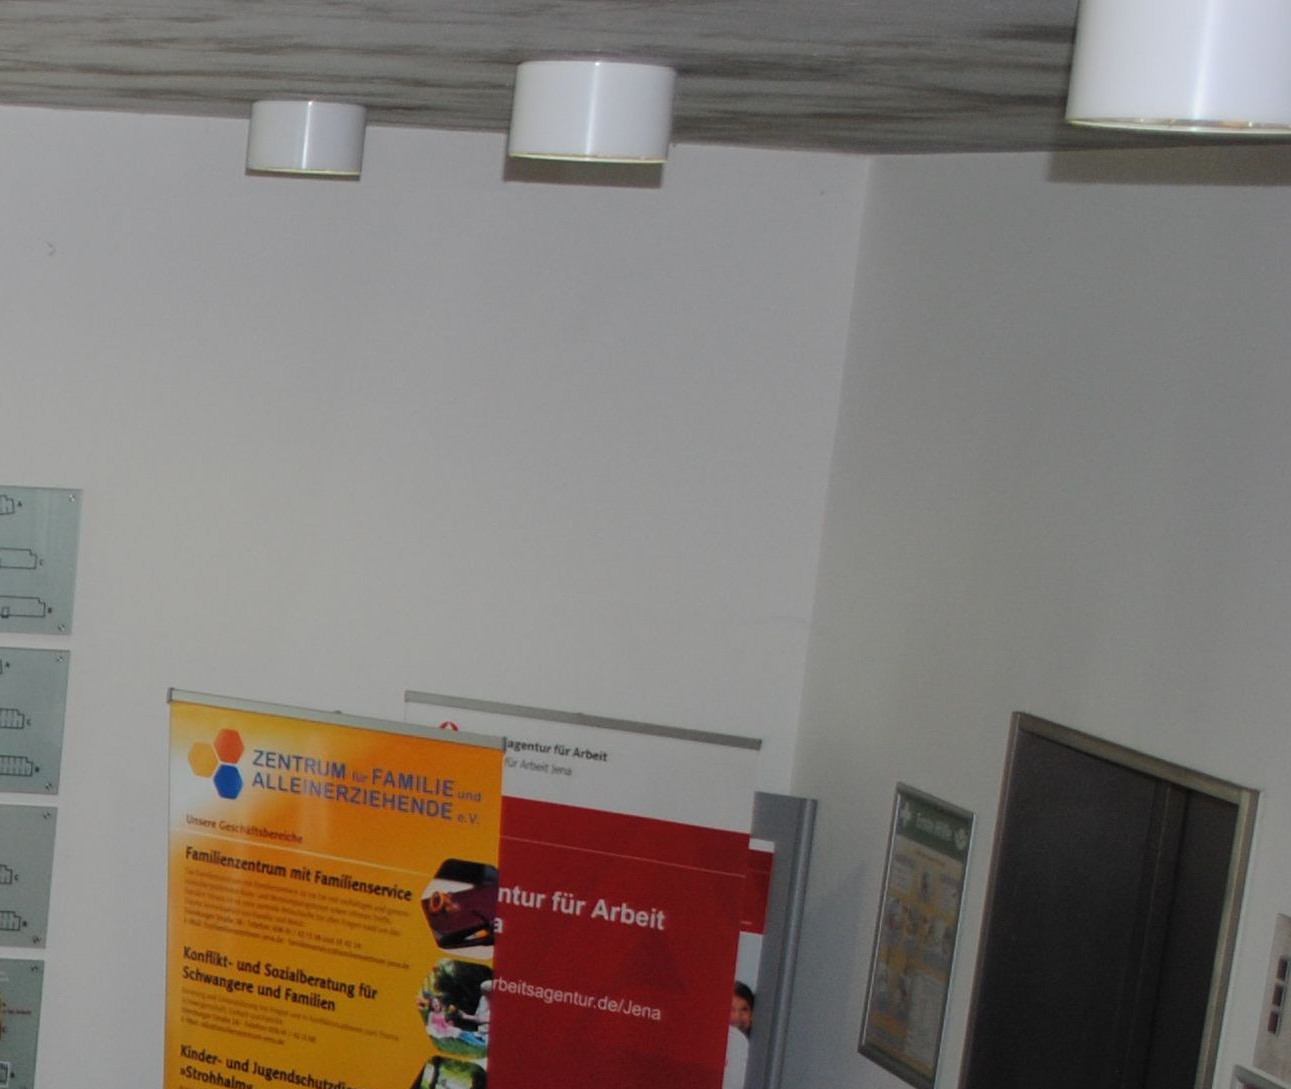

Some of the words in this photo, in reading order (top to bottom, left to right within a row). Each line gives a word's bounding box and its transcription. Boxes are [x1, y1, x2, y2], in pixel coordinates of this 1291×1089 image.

[252, 749, 346, 780] ZENTRUM
[371, 768, 455, 798] FAMILIE
[457, 789, 482, 802] und
[519, 760, 549, 774] Arbeit
[550, 765, 572, 776] Jena
[553, 744, 571, 756] für
[572, 747, 608, 762] Arbeit
[251, 772, 453, 821] ALLEINERZIEHENDE
[456, 813, 480, 825] e.V.
[186, 813, 217, 830] Unsere
[218, 820, 303, 844] Geschäftsbereiche
[185, 846, 287, 878] Familienzentrum
[290, 867, 311, 882] mit
[314, 871, 413, 902] Familienservice
[497, 885, 546, 910] ntur
[551, 891, 587, 917] für
[590, 898, 666, 931] Arbeit
[182, 945, 233, 969] Konflikt-
[236, 960, 261, 975] und
[264, 962, 355, 999] Sozialberatung
[358, 982, 378, 1000] für
[182, 966, 254, 994] Schwangere
[257, 984, 281, 1000] und
[284, 988, 336, 1012] Familien
[180, 1044, 223, 1066] Kinder-
[225, 1058, 249, 1073] und
